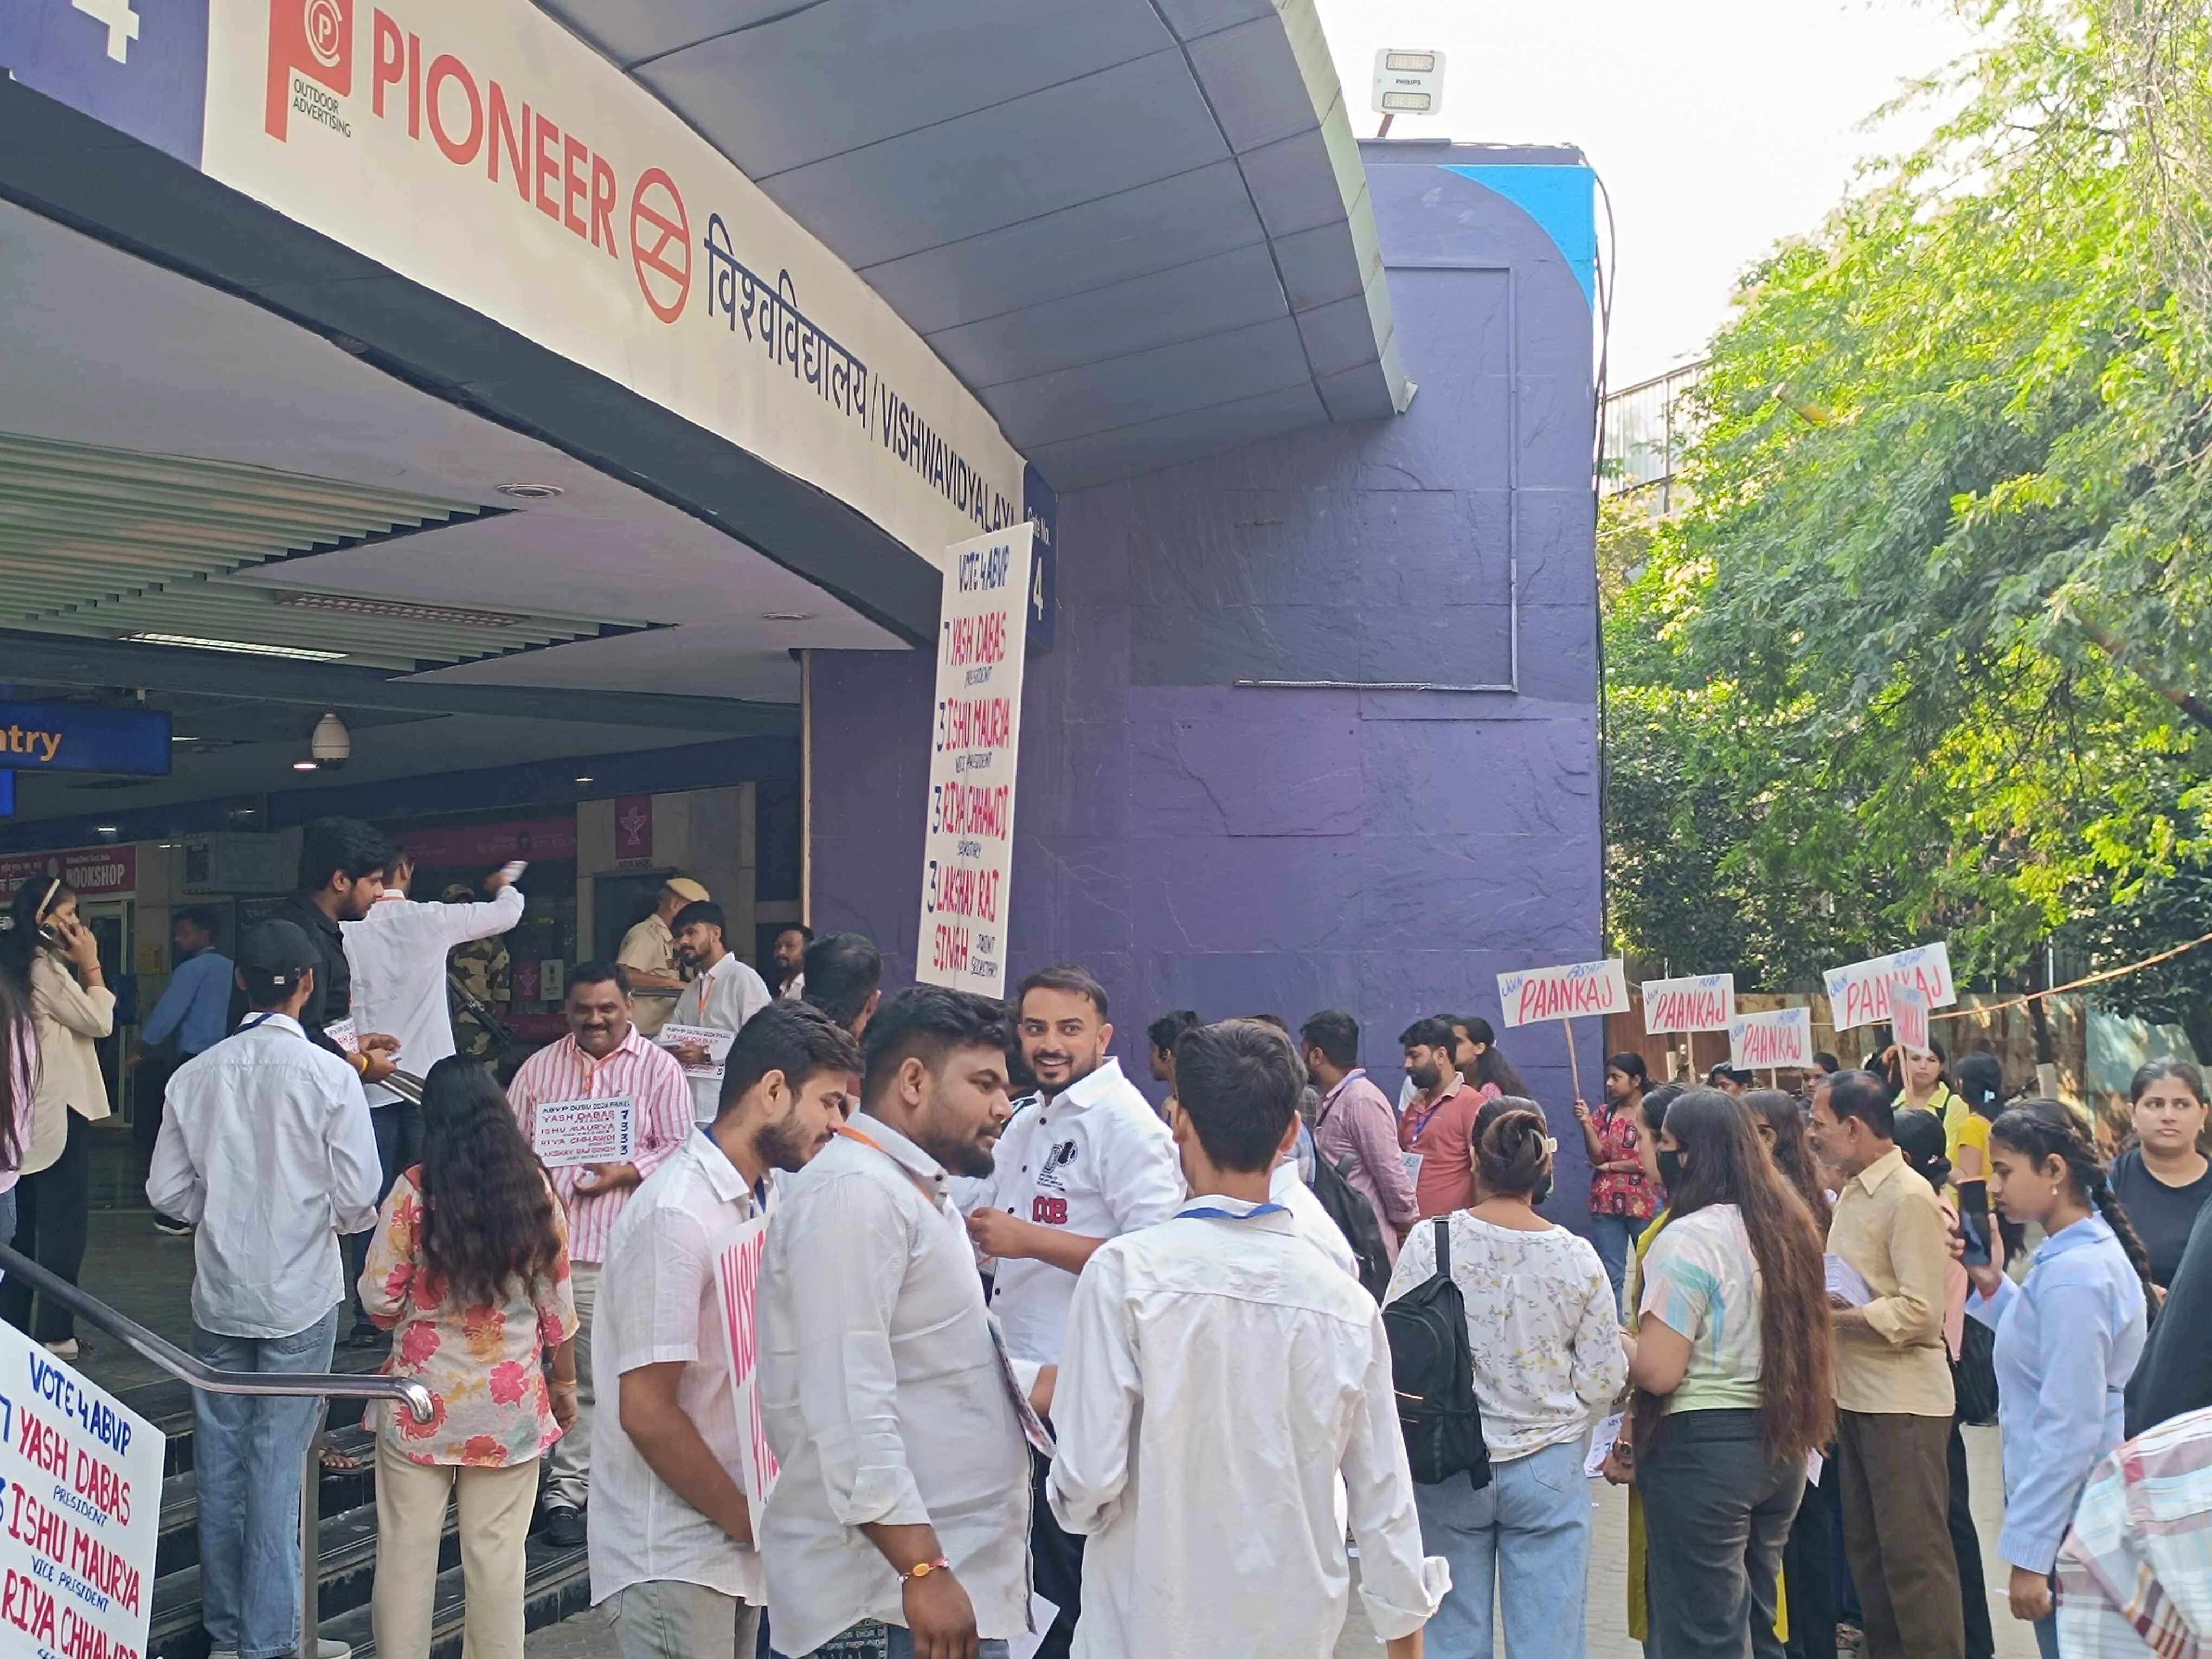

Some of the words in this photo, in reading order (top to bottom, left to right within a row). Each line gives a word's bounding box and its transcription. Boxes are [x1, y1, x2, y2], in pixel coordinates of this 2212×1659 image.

[293, 79, 339, 114] OUTDOOR
[293, 95, 351, 137] ADVERTISING
[372, 7, 619, 260] PIONEER
[704, 213, 867, 429] विश्वविद्यालय
[959, 551, 979, 594] VOTE
[1033, 556, 1043, 621] 4
[951, 616, 974, 666] YASH
[976, 611, 1007, 664] DABAS
[973, 697, 1009, 749] MAURYA
[933, 786, 941, 834] 3
[942, 781, 966, 837] RIYA
[66, 864, 125, 889] BOOKSHOP
[928, 860, 937, 914] 3
[978, 869, 1001, 923] RAJ
[933, 923, 969, 972] SINGH
[1502, 975, 1525, 997] JOIN
[1567, 962, 1605, 979] ASAP
[1518, 975, 1613, 1025] PAANKAJ
[1652, 989, 1726, 1029] PAANKAJ
[1741, 1023, 1802, 1067] PAANKAJ
[541, 1127, 566, 1135] ISHU
[570, 1123, 615, 1132] MAURYA
[621, 1122, 628, 1132] 3
[542, 1105, 568, 1114] ABVP
[542, 1114, 573, 1123] YASH
[577, 1110, 615, 1120] DABAS
[620, 1109, 629, 1120] 7
[620, 1133, 628, 1144] 3
[620, 1145, 628, 1155] 3
[30, 1351, 74, 1418] VOTE
[18, 1406, 69, 1482] YASH
[75, 1448, 131, 1526] DABAS
[53, 1484, 108, 1527] PRESIDENT
[8, 1482, 68, 1564] ISHU
[71, 1527, 139, 1618] MAURYA
[31, 1555, 55, 1583] VICE
[1, 1568, 55, 1651] RIYA
